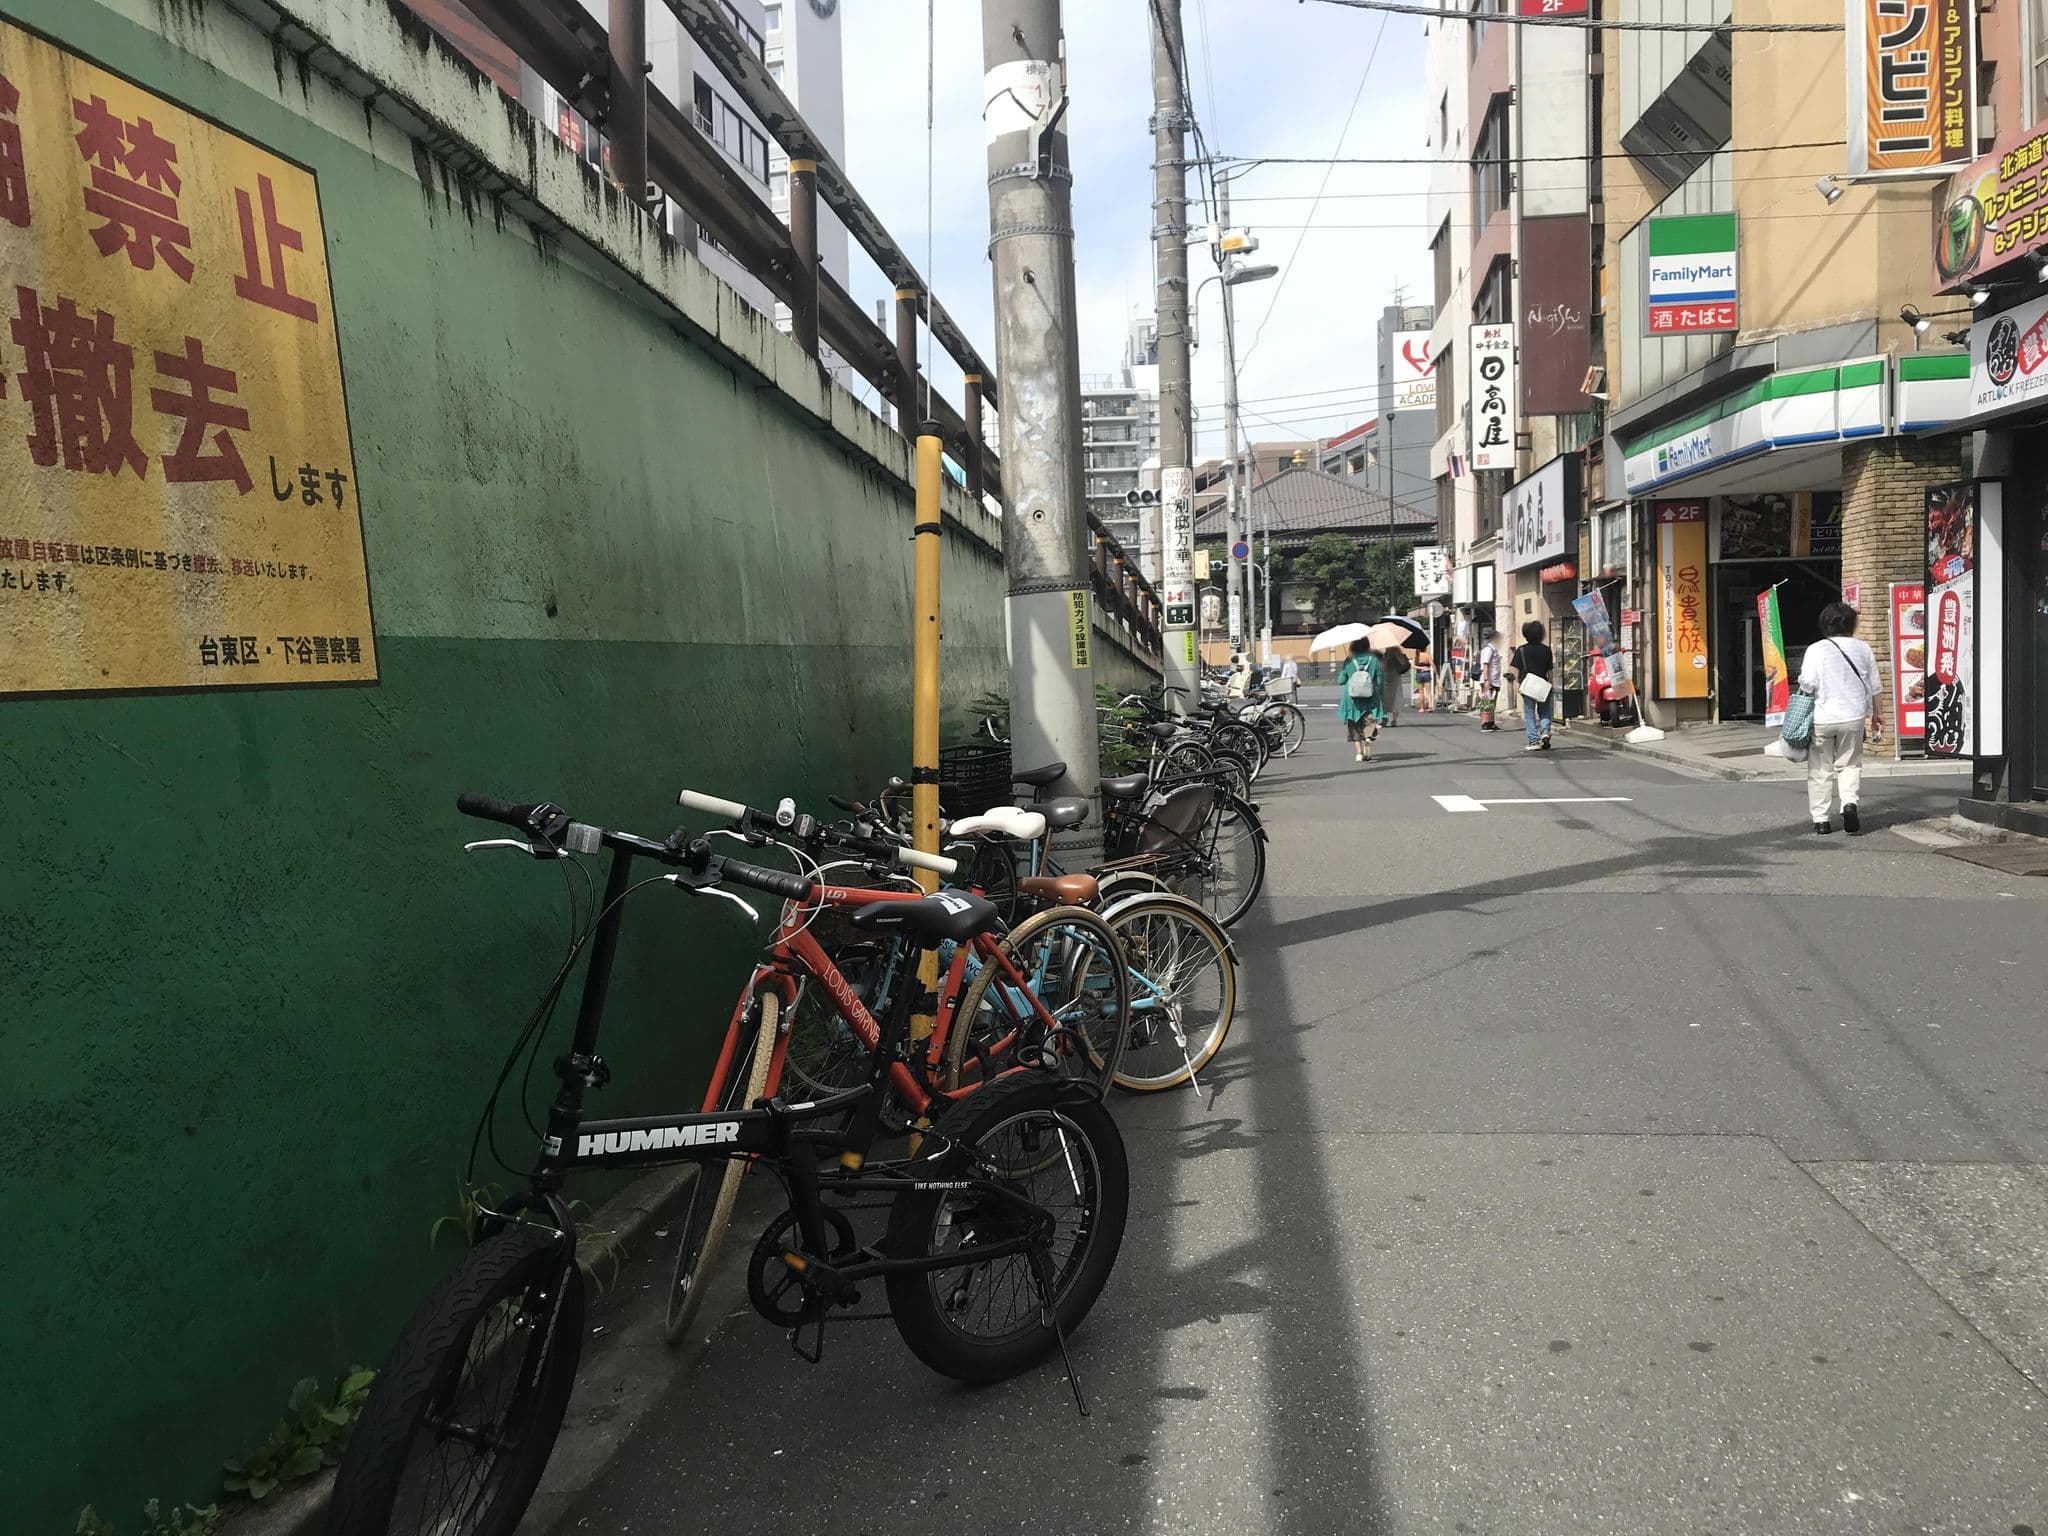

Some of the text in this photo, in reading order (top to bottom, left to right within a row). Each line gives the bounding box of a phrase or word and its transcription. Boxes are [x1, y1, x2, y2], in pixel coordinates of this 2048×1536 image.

[1652, 265, 1732, 282] FamilyMart
[1653, 308, 1732, 328] 酒・たばこ
[1479, 356, 1509, 448] 日高屋
[1668, 434, 1712, 467] FamilyMart
[1678, 506, 1699, 520] 2F
[1664, 565, 1673, 652] TORIKIZOKU
[1073, 592, 1087, 665] 防犯カメラ設置地域
[199, 635, 362, 667] 台東区・下谷警察署
[822, 960, 855, 1007] LOUIS
[577, 1122, 740, 1157] HUMMER
[914, 1182, 927, 1190] LIKE
[928, 1182, 953, 1190] NOTHING
